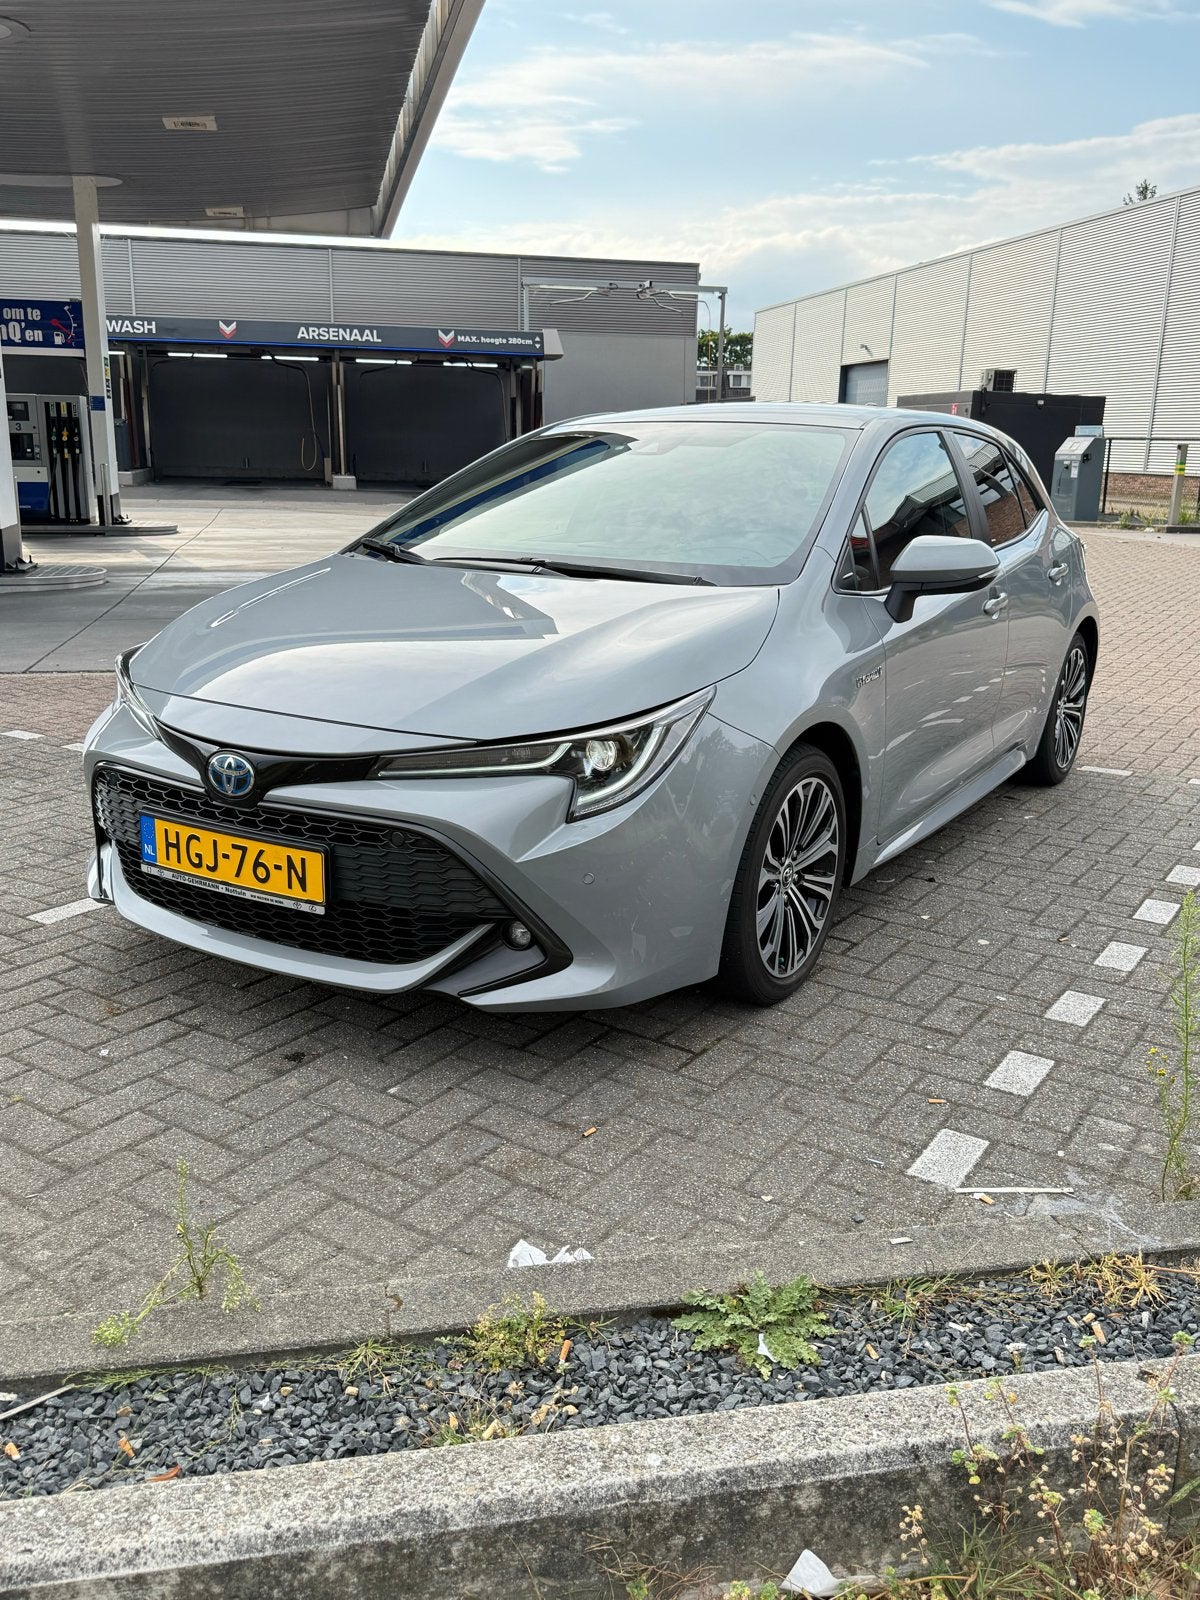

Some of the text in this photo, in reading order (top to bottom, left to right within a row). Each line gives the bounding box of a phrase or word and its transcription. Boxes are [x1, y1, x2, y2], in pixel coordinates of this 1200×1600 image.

[3, 307, 41, 321] om te
[106, 319, 156, 334] WASH
[297, 326, 382, 343] ARSENAAL
[457, 335, 533, 345] MAX. hoogte 280cm
[15, 423, 22, 431] 3
[144, 843, 155, 856] NL
[164, 827, 307, 893] HGJ-76-N
